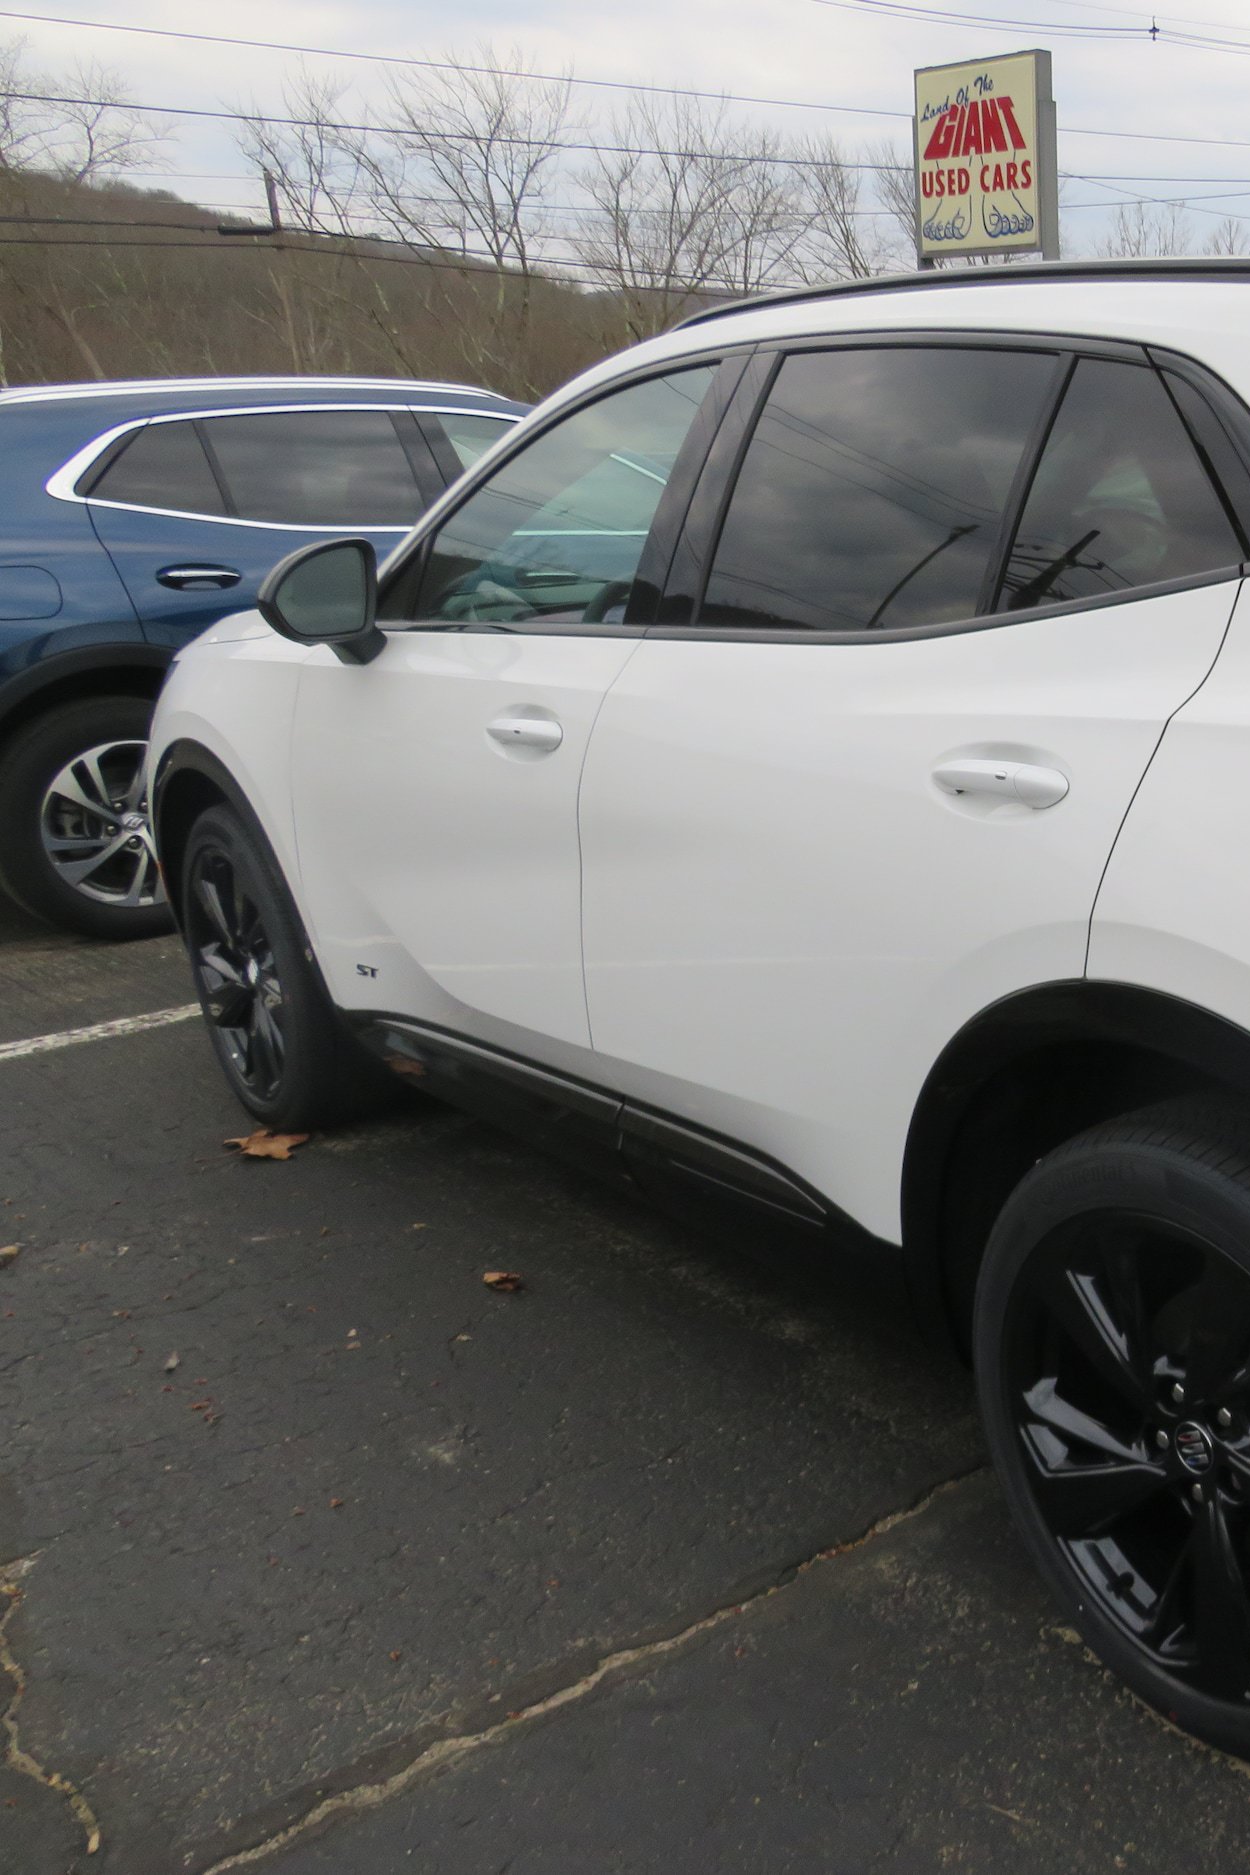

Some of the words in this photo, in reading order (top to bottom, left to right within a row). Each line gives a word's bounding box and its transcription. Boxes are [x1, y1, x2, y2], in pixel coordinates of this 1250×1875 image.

[921, 95, 950, 122] Land
[956, 85, 970, 107] Of
[974, 73, 994, 96] The
[923, 95, 1027, 160] GIANT
[921, 167, 970, 198] USED
[980, 159, 1032, 193] CARS
[356, 963, 379, 979] ST
